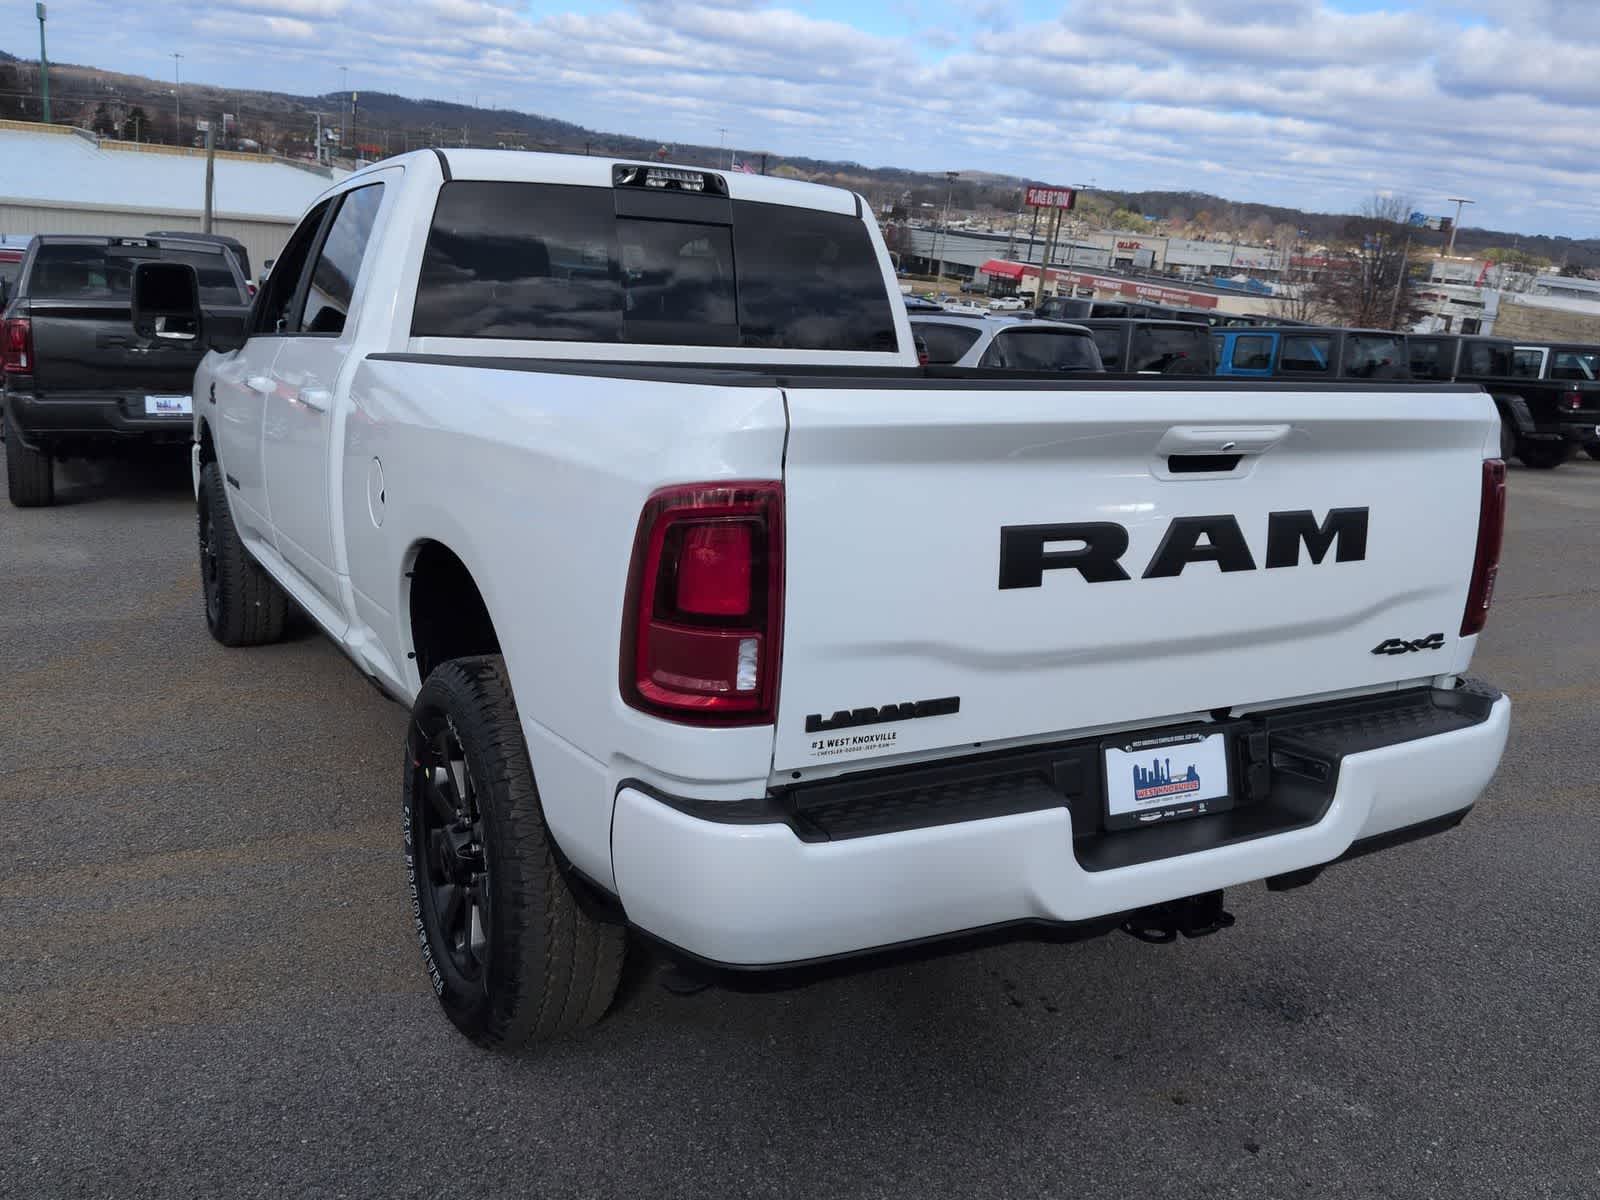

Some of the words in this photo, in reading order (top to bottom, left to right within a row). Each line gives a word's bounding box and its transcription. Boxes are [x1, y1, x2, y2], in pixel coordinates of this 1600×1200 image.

[998, 506, 1369, 590] RAM
[827, 737, 850, 748] WEST
[852, 732, 896, 744] KNOXVILLE
